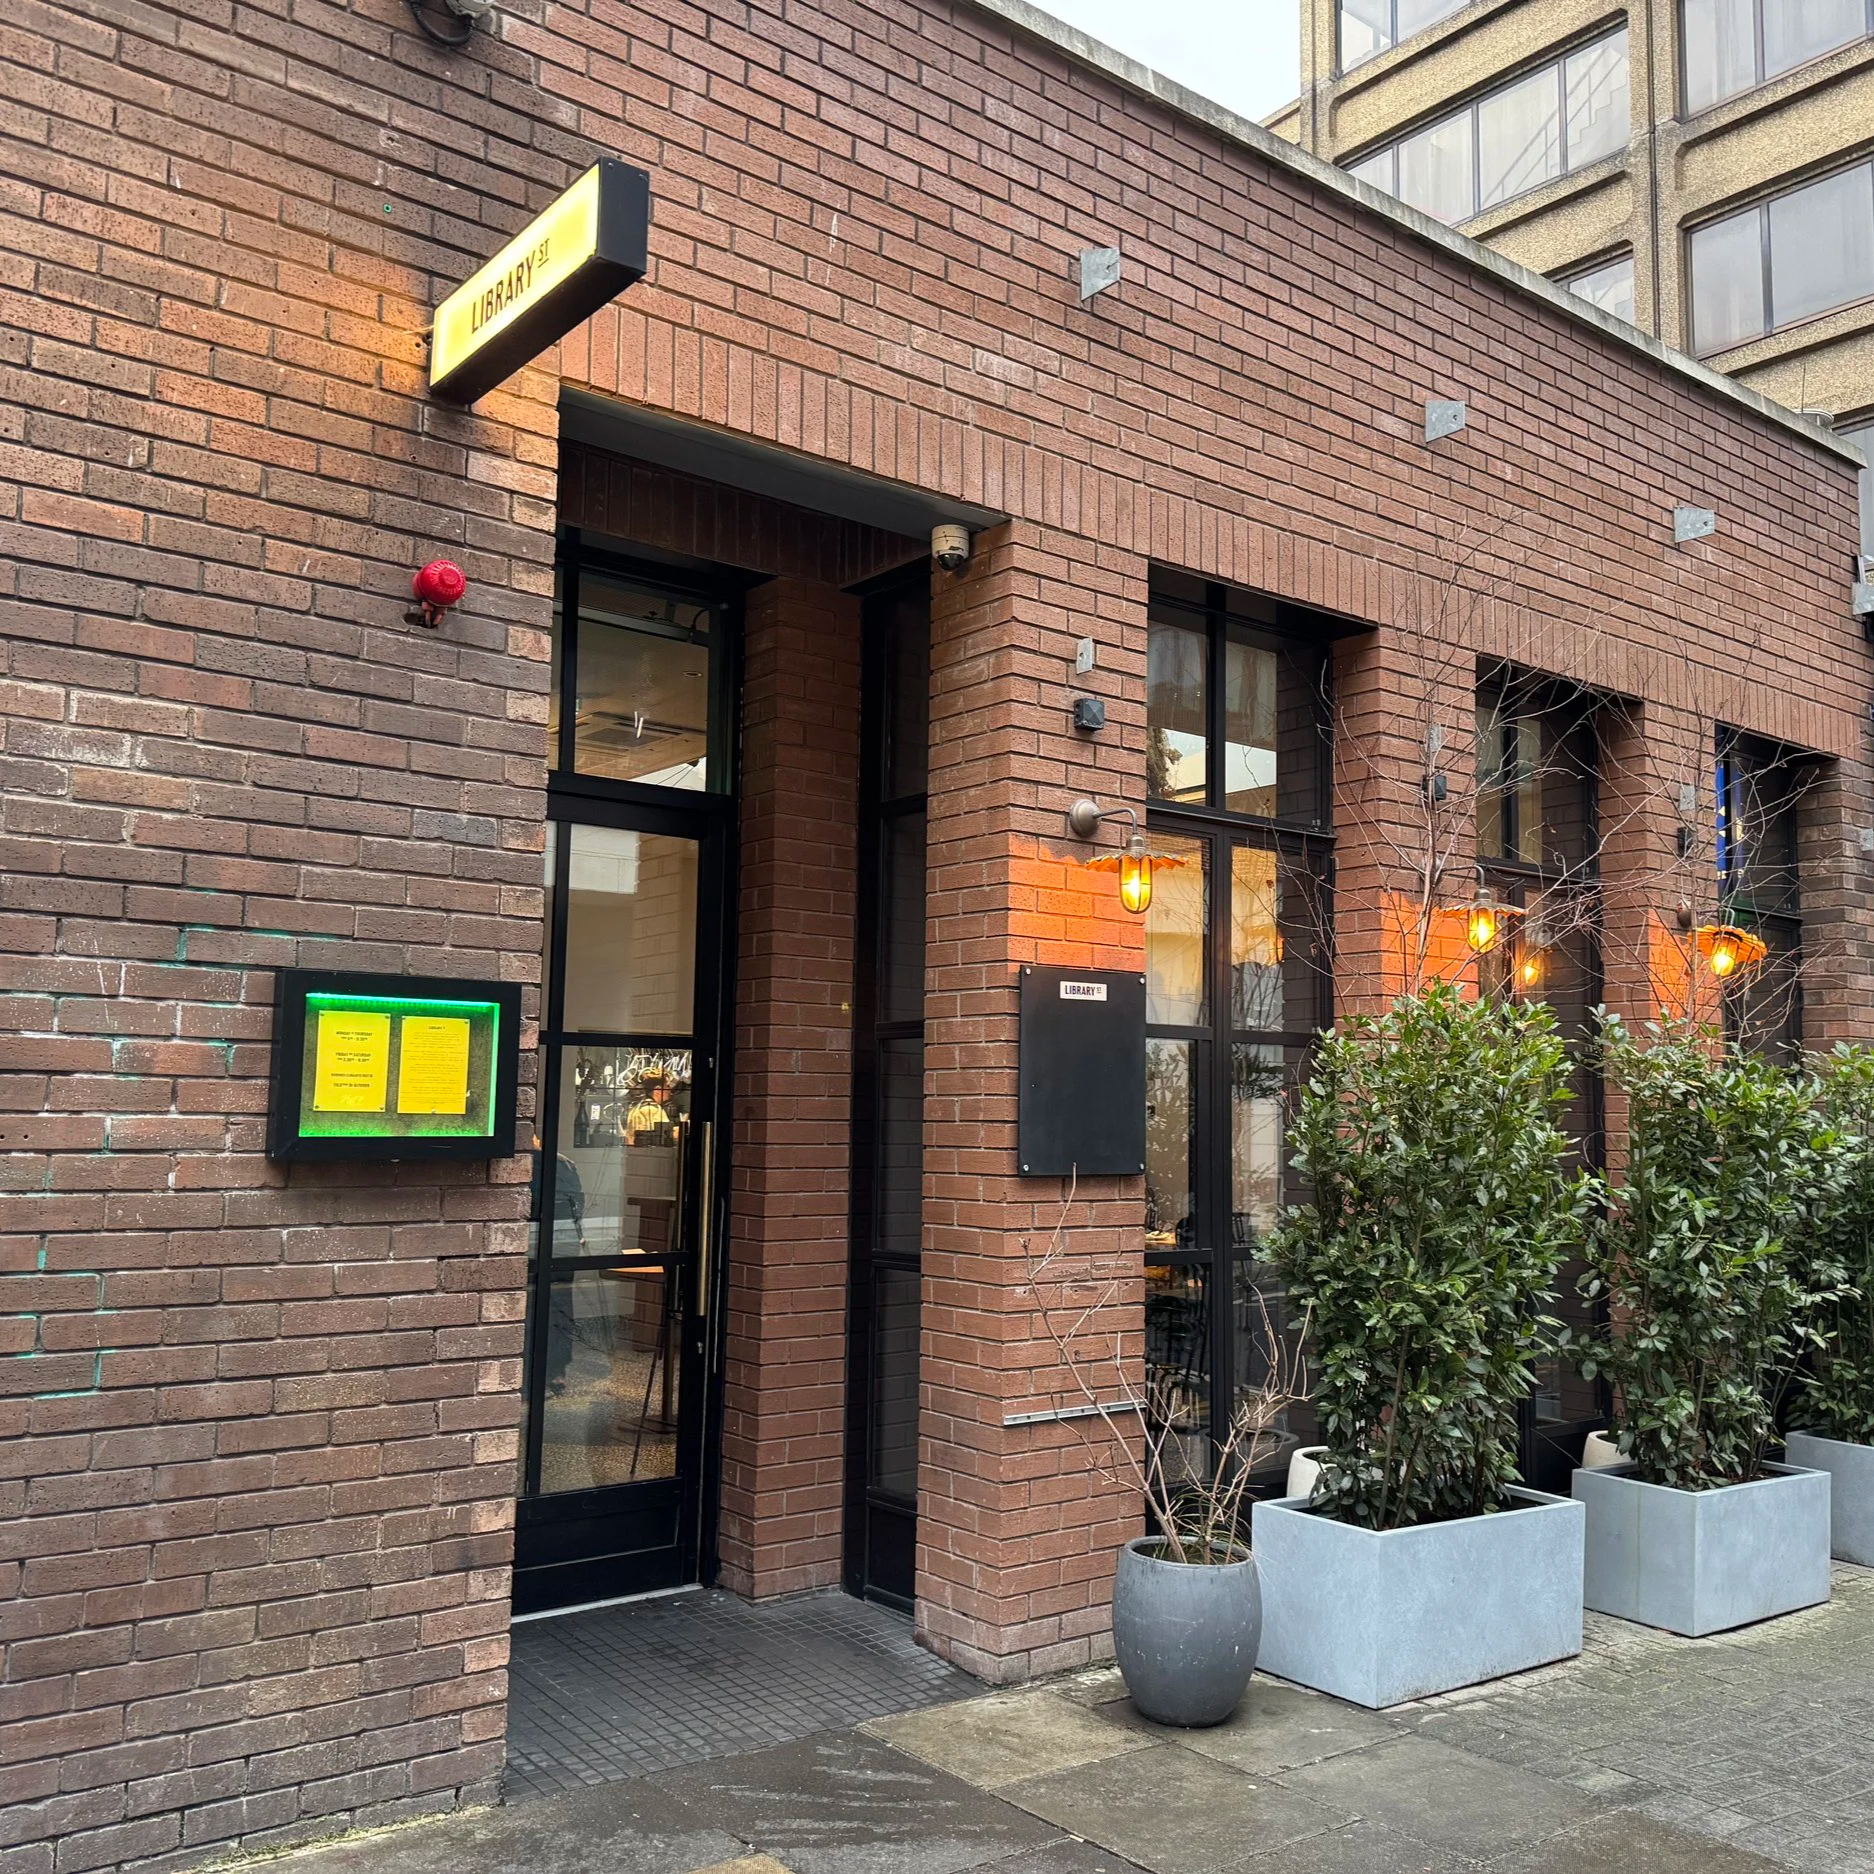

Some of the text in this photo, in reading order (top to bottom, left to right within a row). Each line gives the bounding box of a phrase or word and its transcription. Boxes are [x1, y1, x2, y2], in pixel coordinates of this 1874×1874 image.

[471, 238, 550, 334] LIBRARY ST
[1064, 985, 1096, 996] LIBRARY
